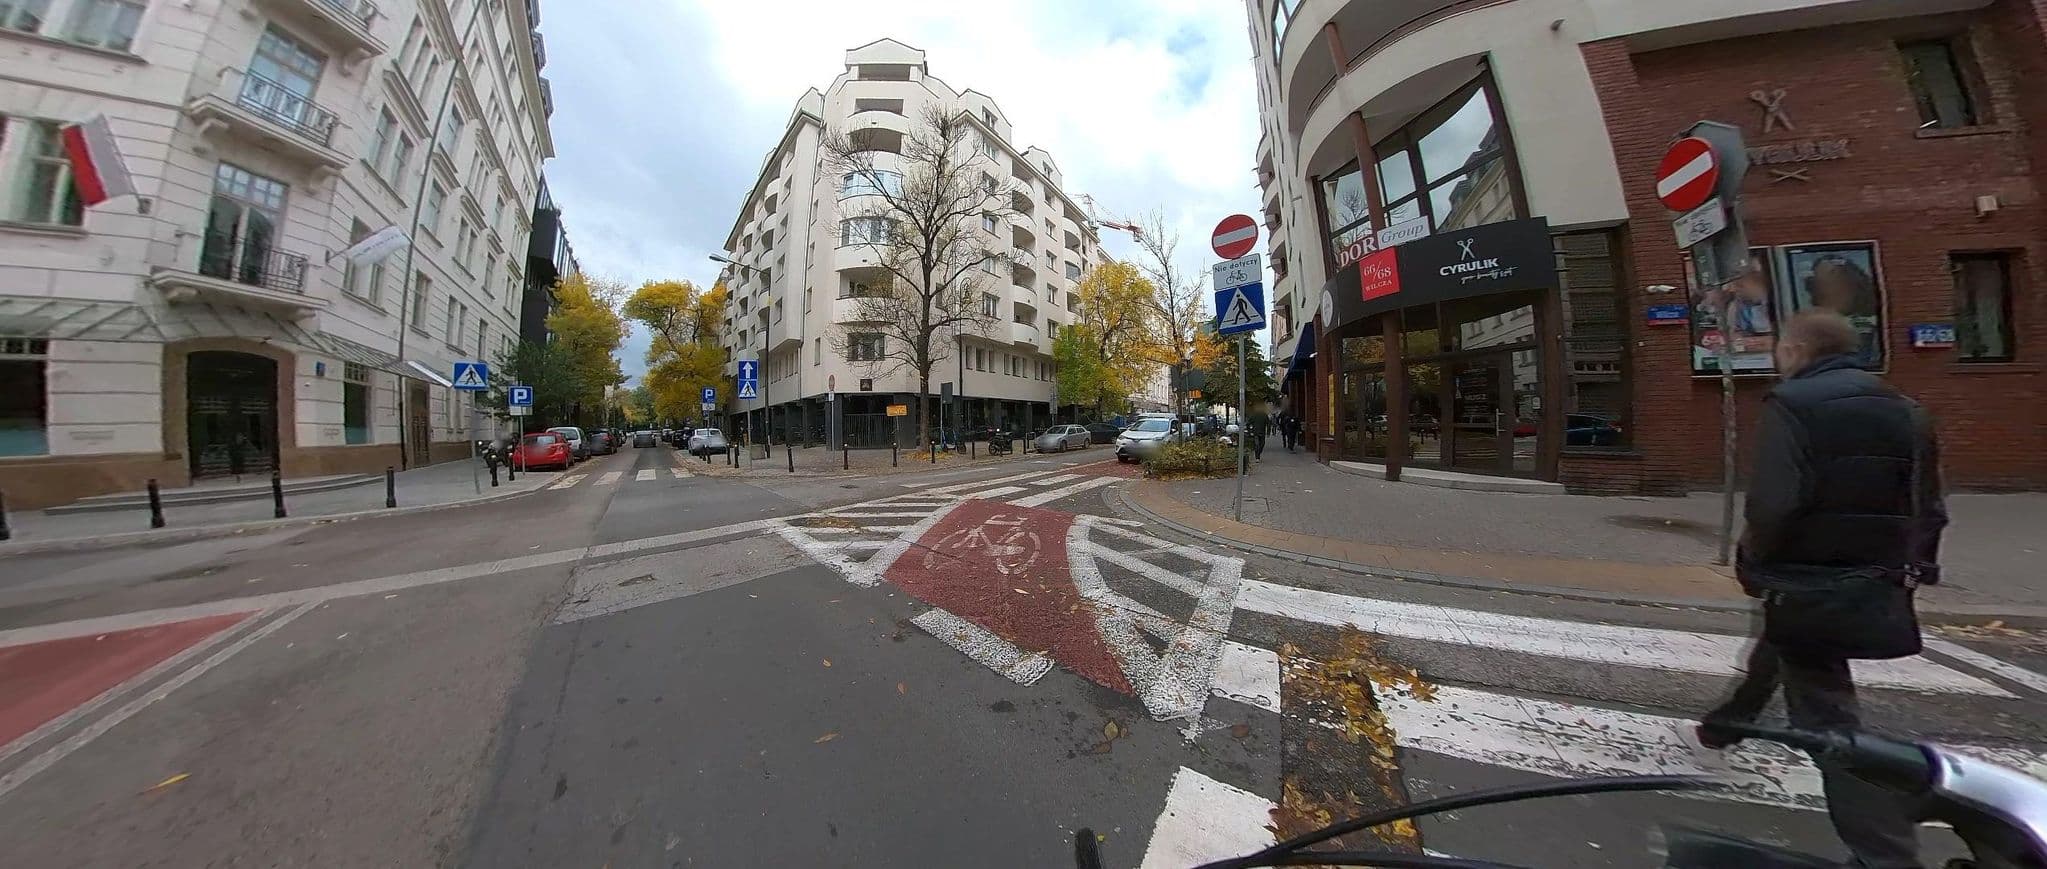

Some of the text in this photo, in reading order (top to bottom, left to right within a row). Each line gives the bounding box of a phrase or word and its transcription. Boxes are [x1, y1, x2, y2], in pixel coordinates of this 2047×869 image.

[1381, 224, 1424, 243] Group
[1230, 259, 1258, 269] dotyczy
[1364, 260, 1392, 281] 66/68
[1440, 258, 1499, 276] CYRULIK
[1365, 280, 1392, 292] WILCZA
